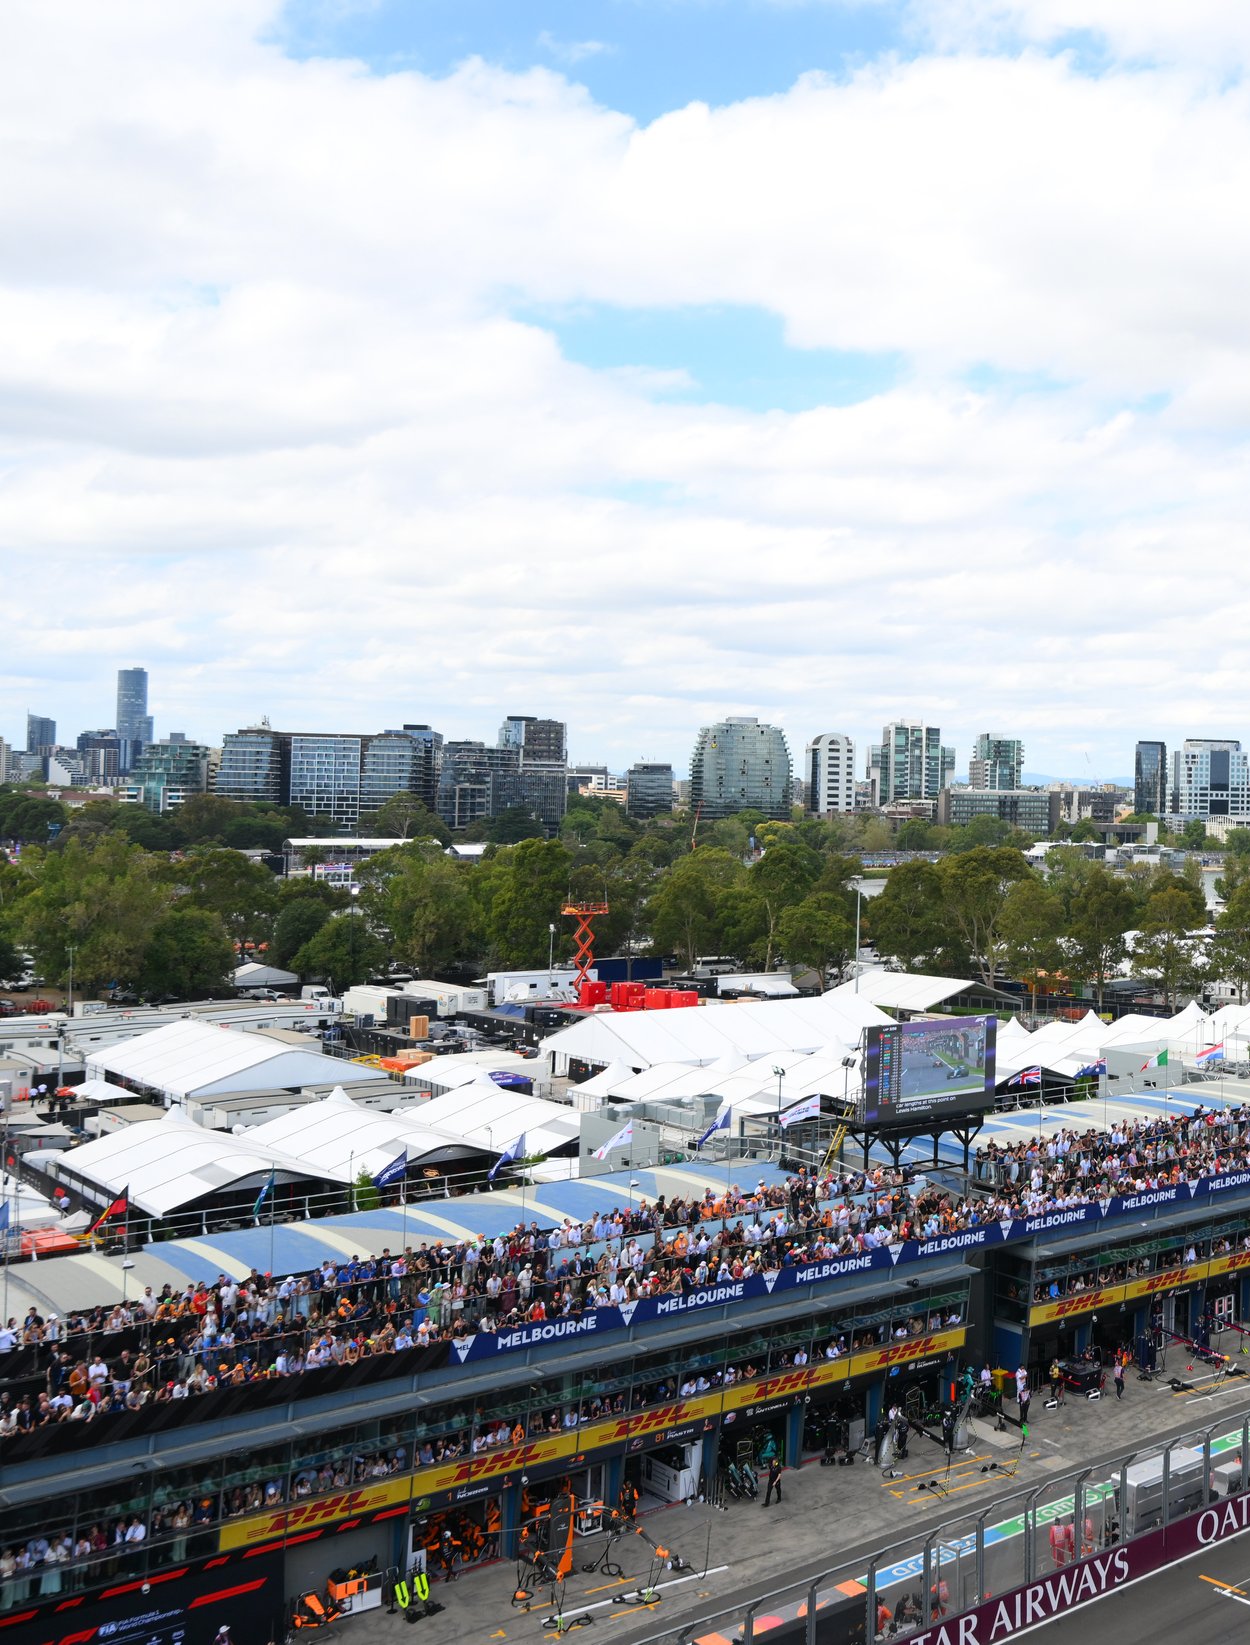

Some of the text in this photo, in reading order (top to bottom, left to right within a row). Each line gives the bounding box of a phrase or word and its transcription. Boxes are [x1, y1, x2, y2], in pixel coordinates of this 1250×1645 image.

[1123, 1189, 1176, 1209] MELBOURNE
[1026, 1209, 1085, 1232] MELBOURNE
[918, 1231, 985, 1256] MELBOURNE
[796, 1256, 872, 1283] MELBOURNE
[1147, 1270, 1190, 1290] DHL
[657, 1284, 744, 1314] MELBOURNE
[1056, 1292, 1104, 1316] DHL
[498, 1316, 597, 1349] MELBOURNE
[456, 1344, 471, 1352] MEL
[877, 1337, 937, 1365] DHL
[753, 1369, 822, 1399] DHL
[756, 1402, 788, 1414] ANTONELLI
[614, 1404, 690, 1437] DHL
[655, 1432, 665, 1442] 81
[667, 1428, 694, 1439] PIASTRI
[453, 1445, 541, 1482] DHL
[448, 1492, 452, 1501] 1
[457, 1487, 489, 1499] NORRIS
[266, 1491, 369, 1533] DHL
[990, 1548, 1129, 1640] AIRWAYS
[100, 1624, 116, 1636] FIA
